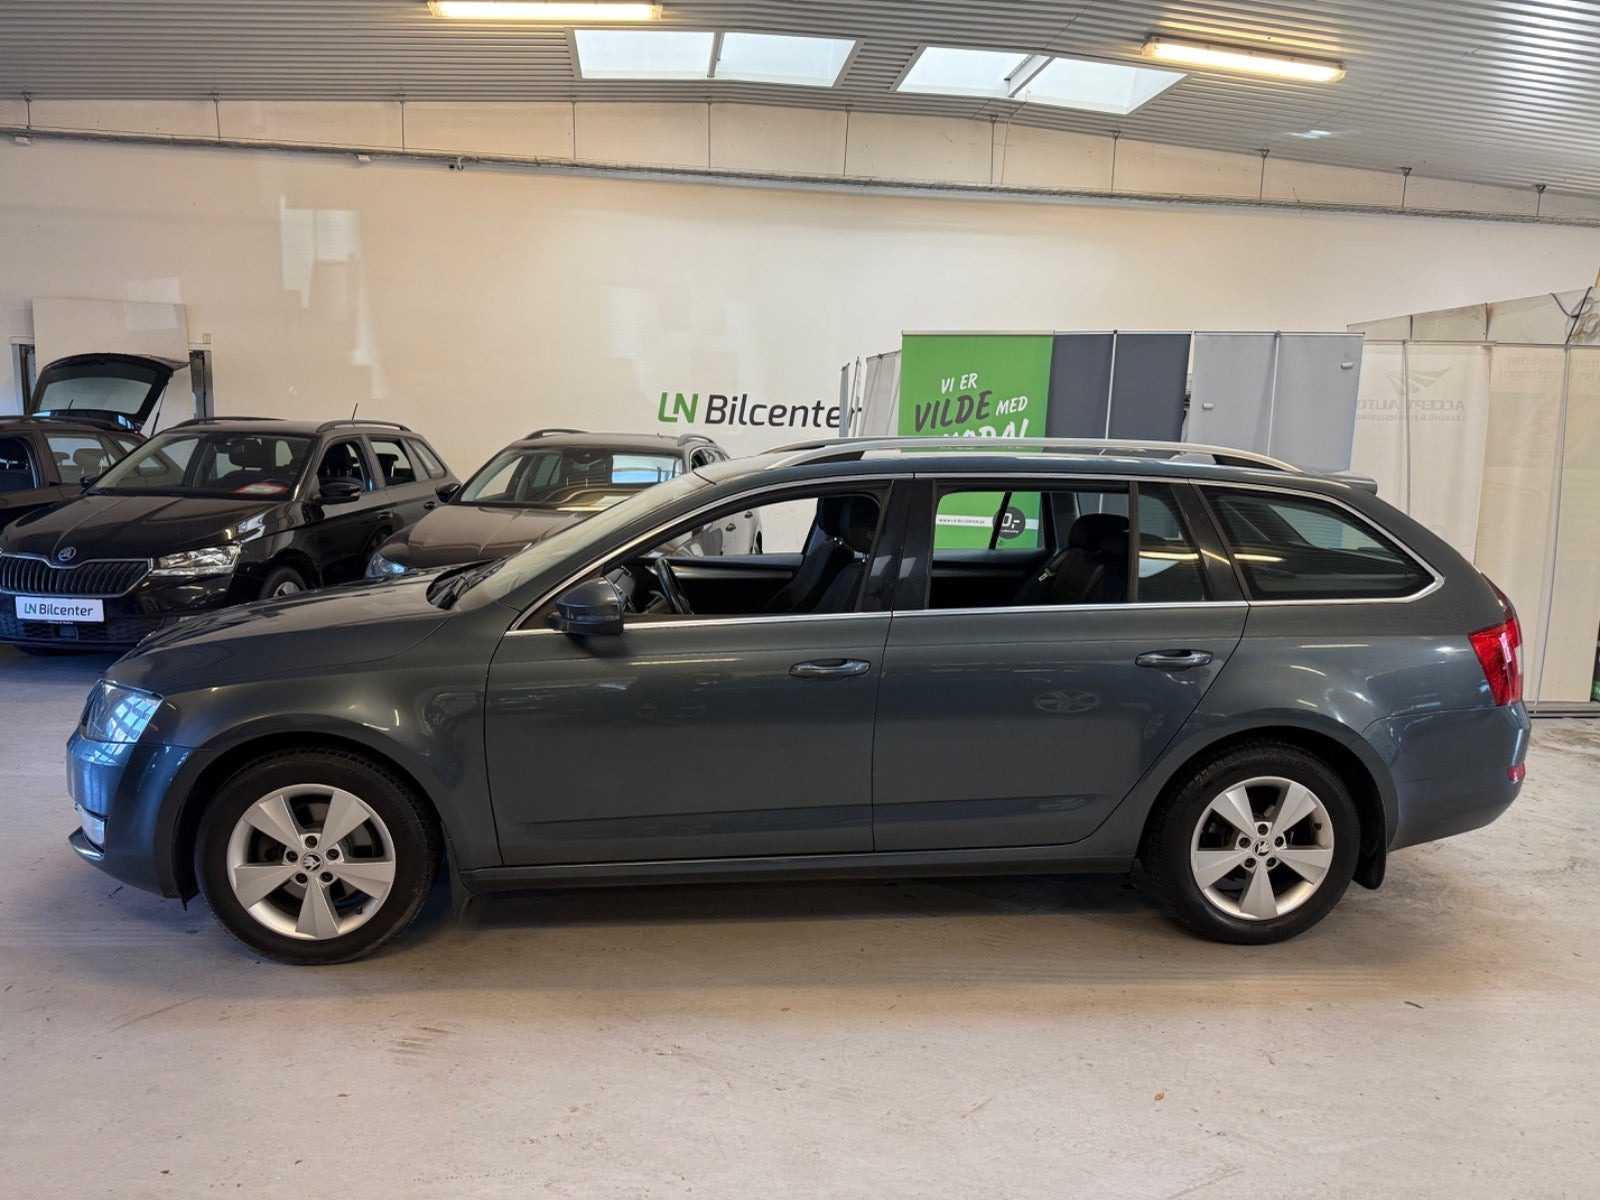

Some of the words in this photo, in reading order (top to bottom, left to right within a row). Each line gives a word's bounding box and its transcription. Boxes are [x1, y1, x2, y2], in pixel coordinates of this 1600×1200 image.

[941, 377, 955, 394] VI
[959, 372, 978, 390] ER
[657, 391, 699, 424] LN
[704, 393, 863, 428] Bilcenter
[914, 389, 993, 433] VILDE
[995, 395, 1028, 417] MED
[24, 603, 37, 614] LN
[39, 604, 93, 616] Bilcenter
